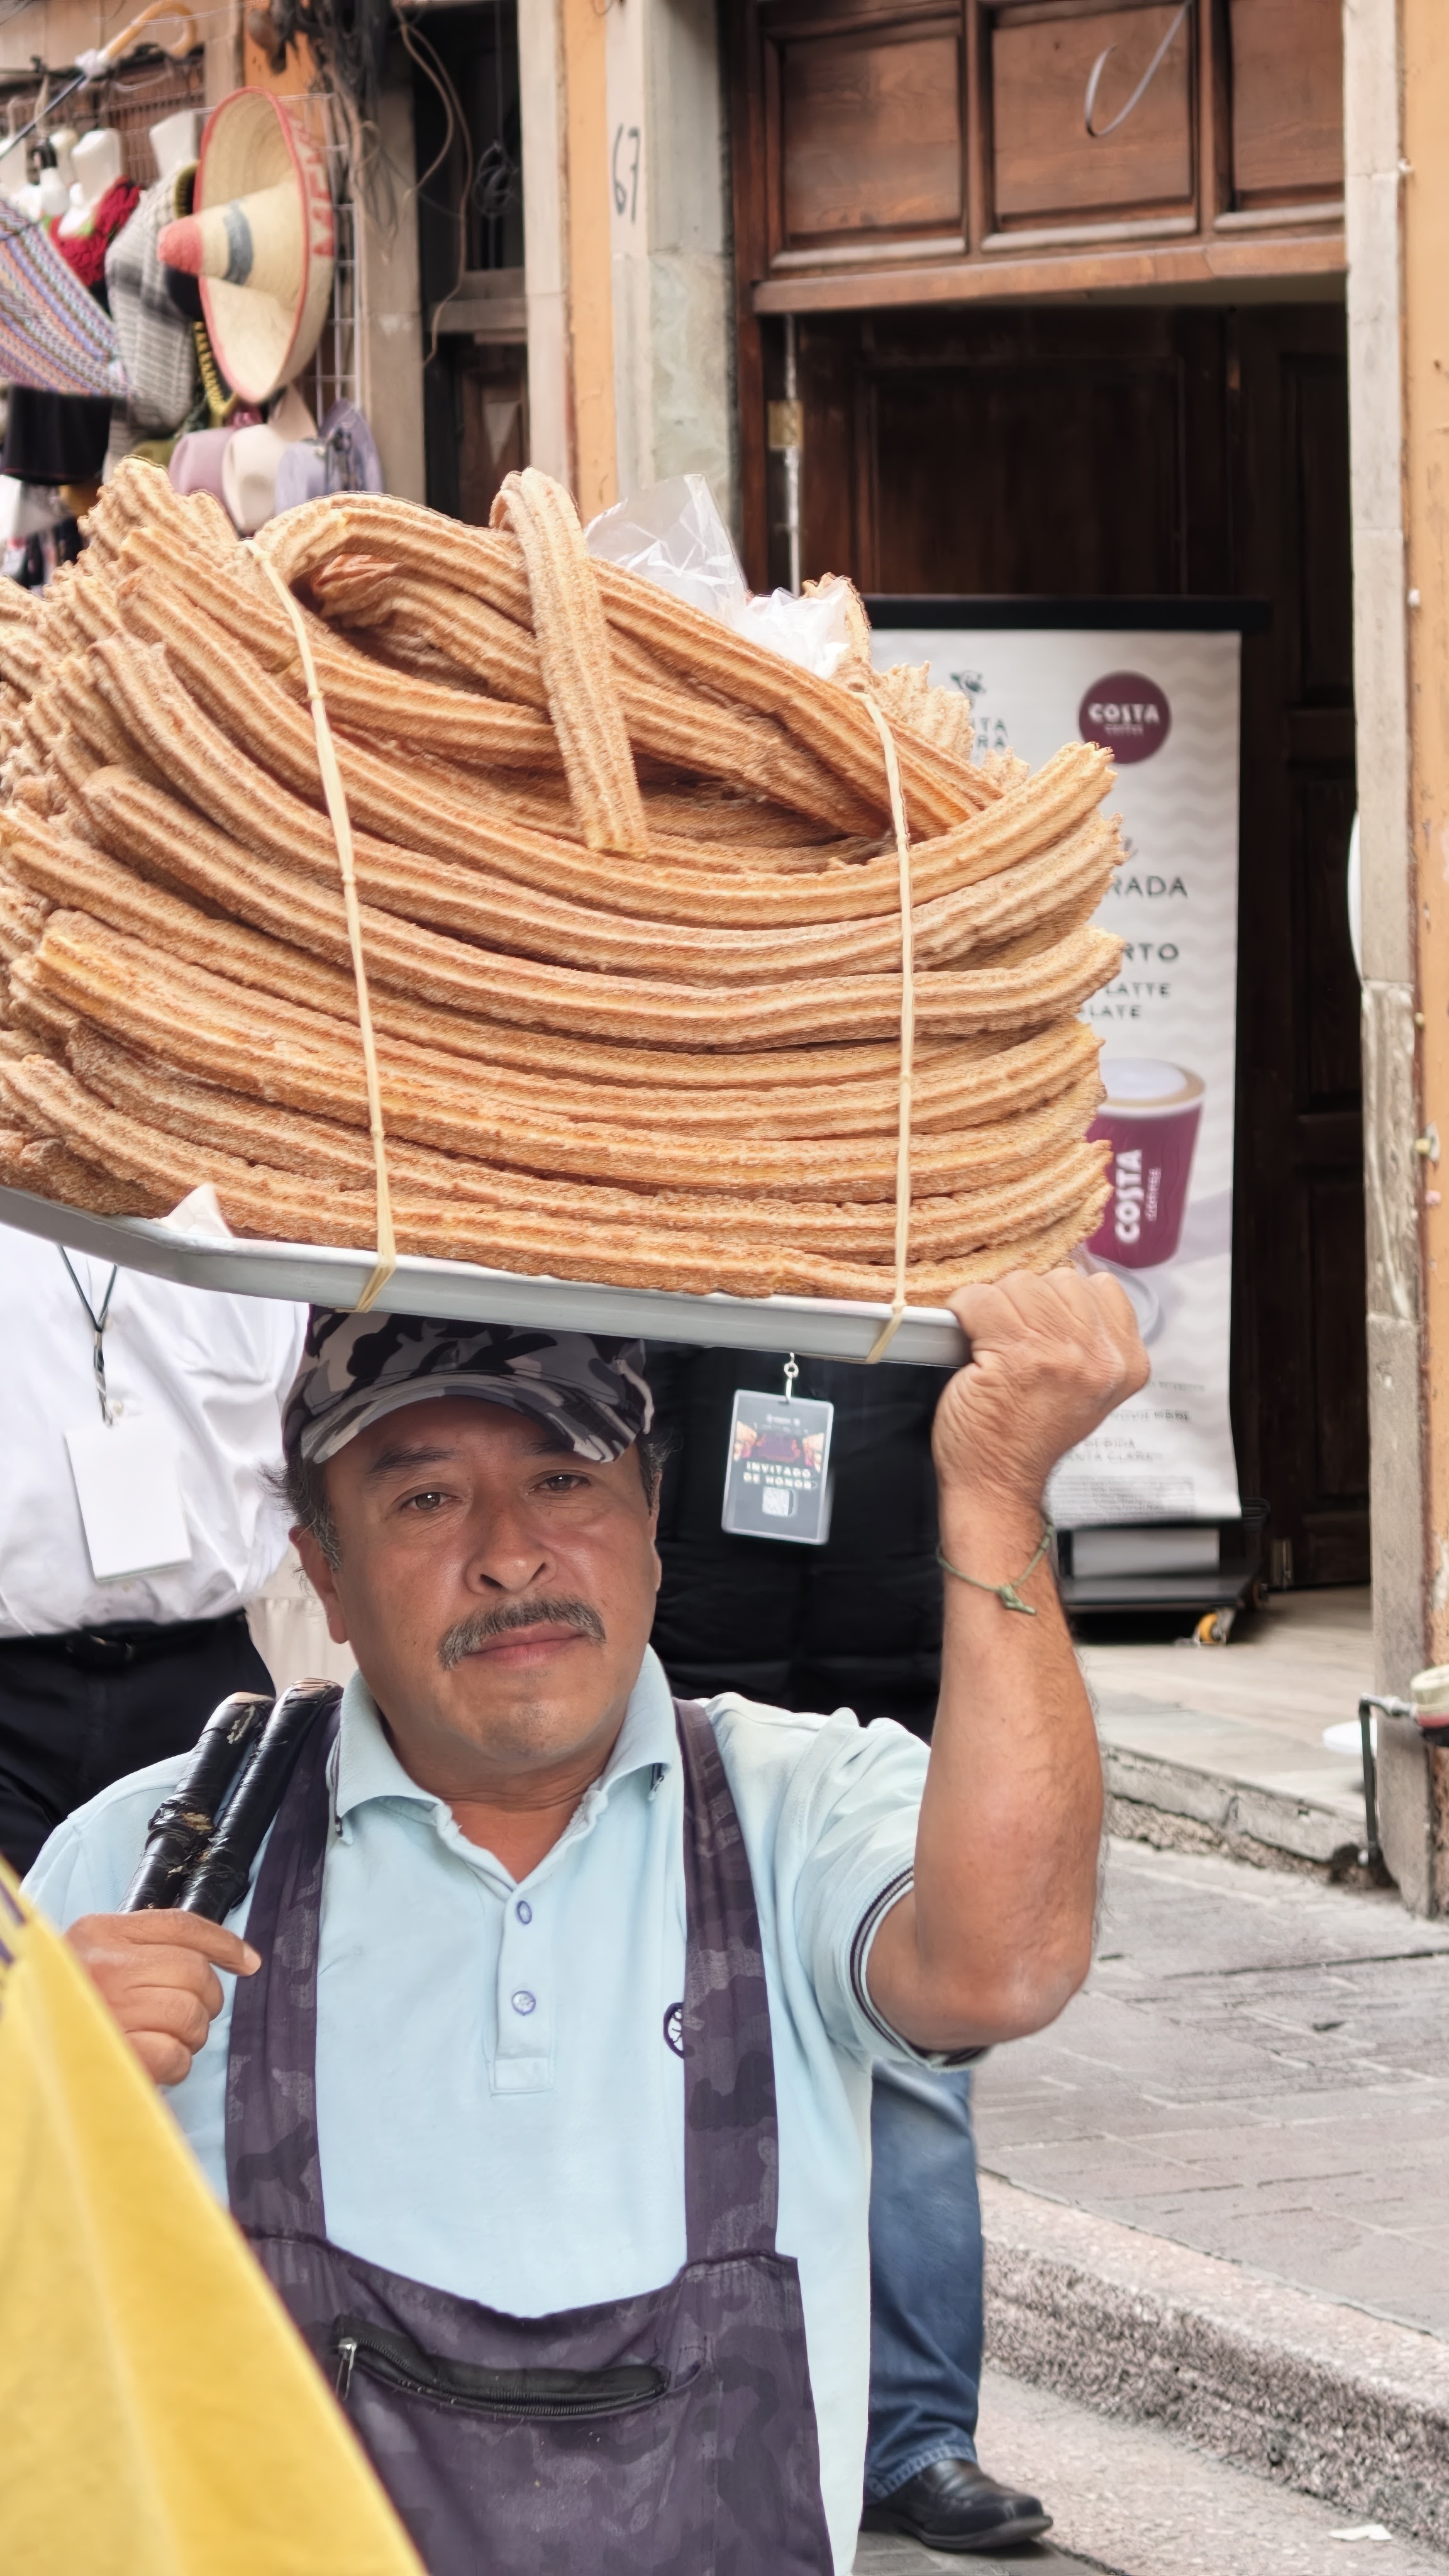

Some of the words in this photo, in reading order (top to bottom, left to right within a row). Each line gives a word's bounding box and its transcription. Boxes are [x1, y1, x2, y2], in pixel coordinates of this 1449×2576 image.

[612, 123, 640, 224] 67
[1088, 702, 1160, 724] COSTA
[1115, 1149, 1145, 1244] COSTA
[747, 1461, 811, 1479] INVITADO
